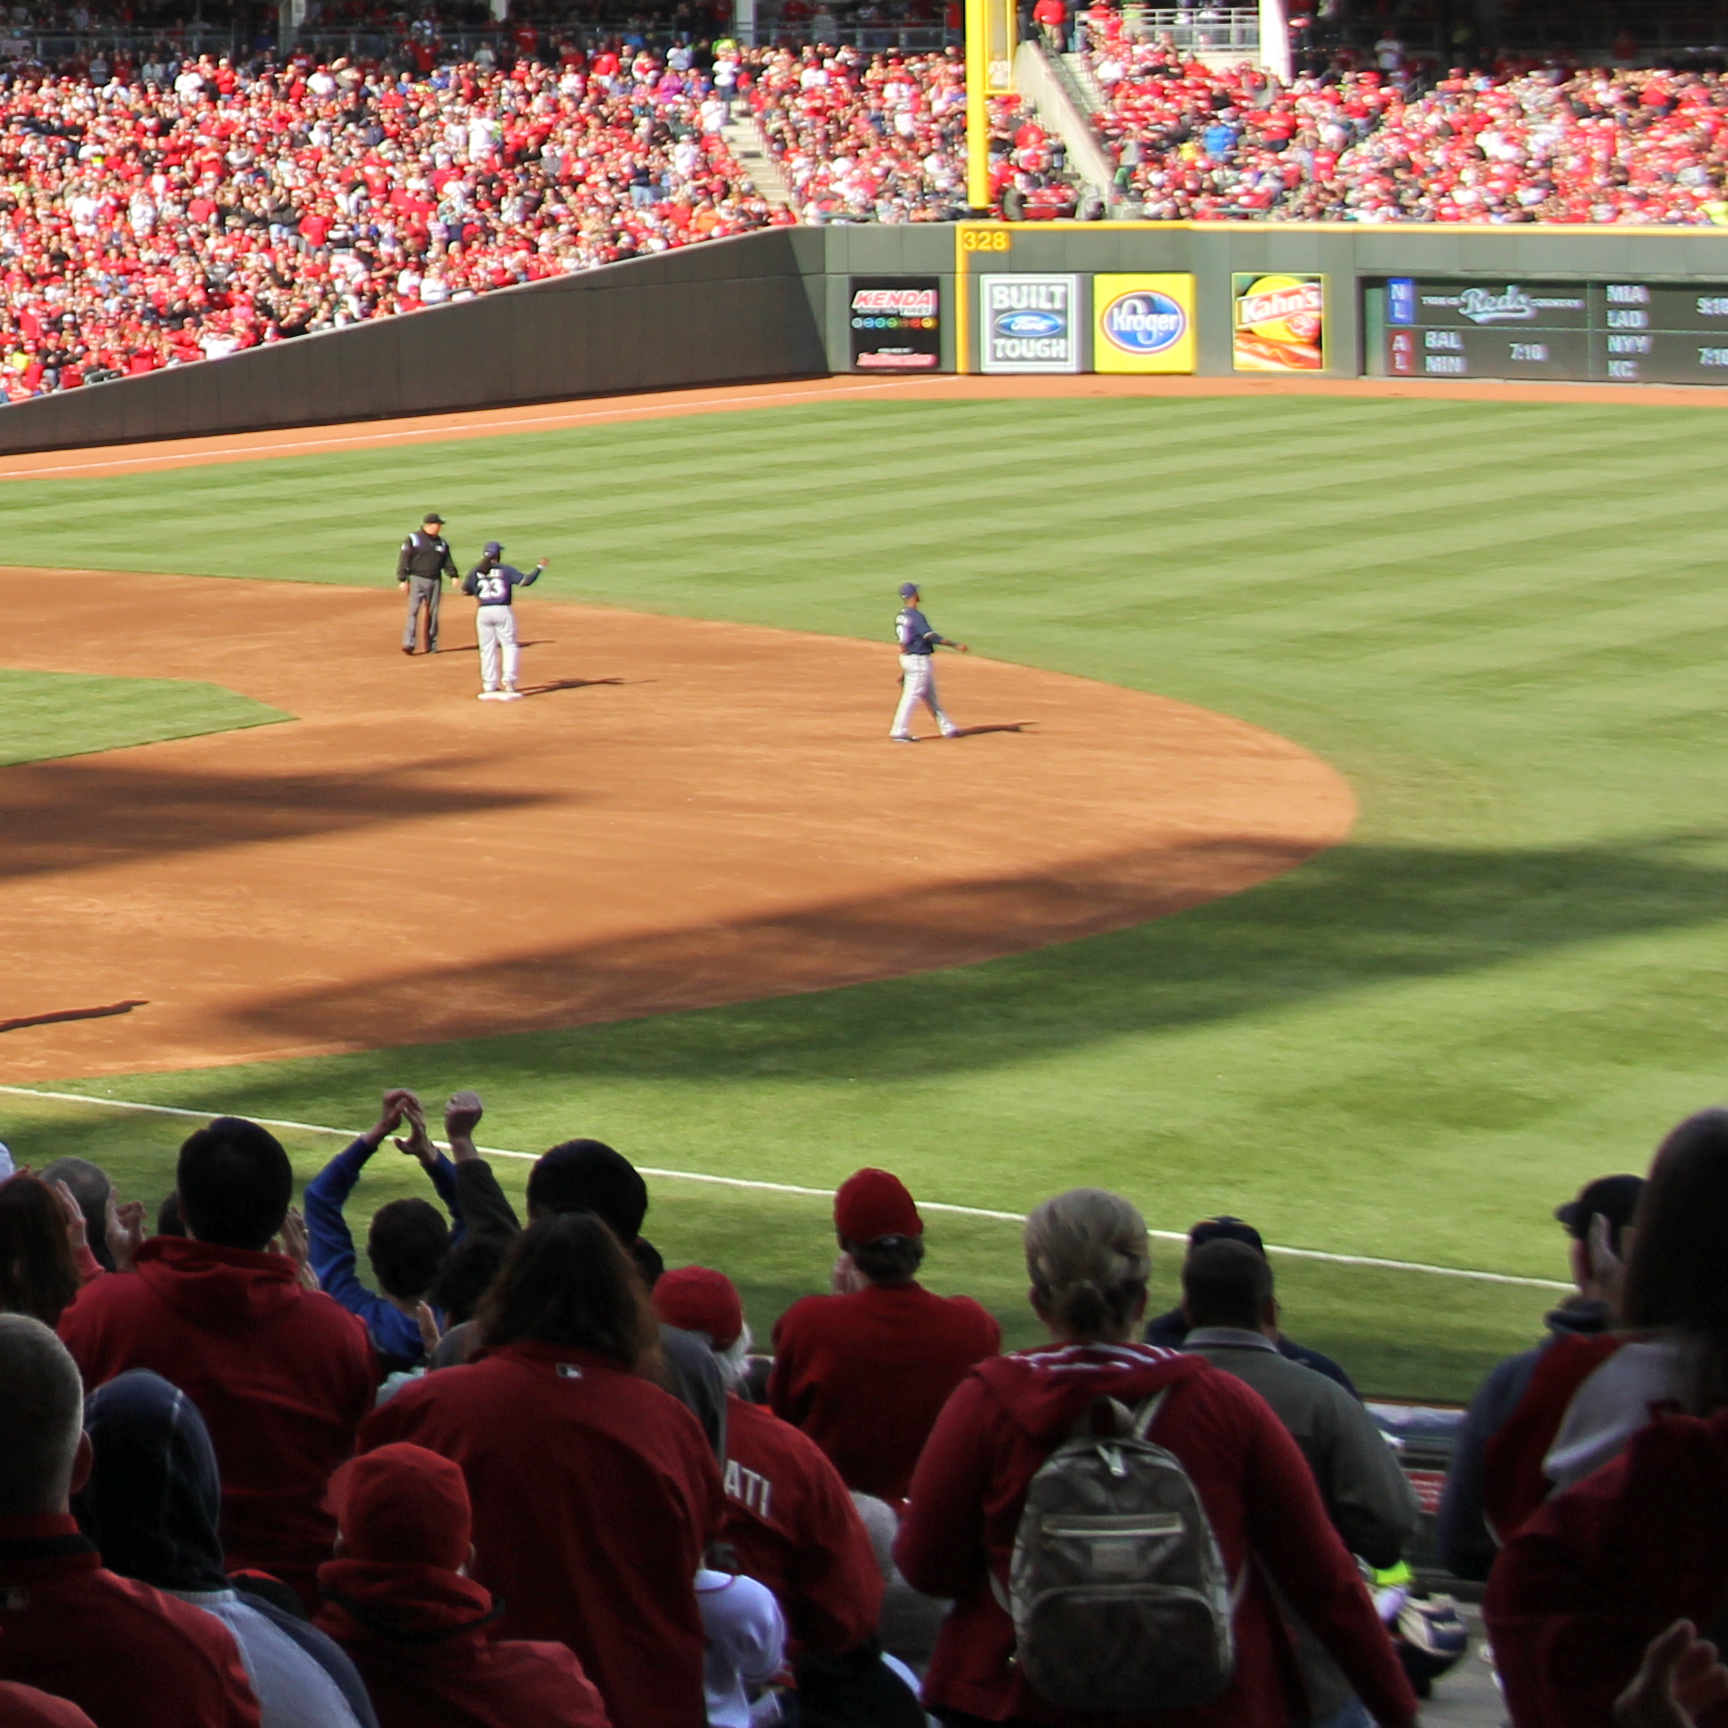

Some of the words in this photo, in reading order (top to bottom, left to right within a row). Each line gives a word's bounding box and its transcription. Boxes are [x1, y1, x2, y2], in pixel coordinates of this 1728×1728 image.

[962, 231, 1010, 252] 328
[852, 290, 933, 308] KENDA
[993, 285, 1066, 310] BUILT
[1606, 285, 1650, 304] MIA
[1242, 286, 1322, 323] Kahn's
[1009, 316, 1047, 332] Ford
[1112, 299, 1179, 345] Kroger
[992, 339, 1067, 359] TOUGH
[1424, 332, 1464, 350] BAL
[1425, 355, 1467, 373] MIN
[1608, 360, 1639, 378] KC
[477, 578, 506, 599] 23
